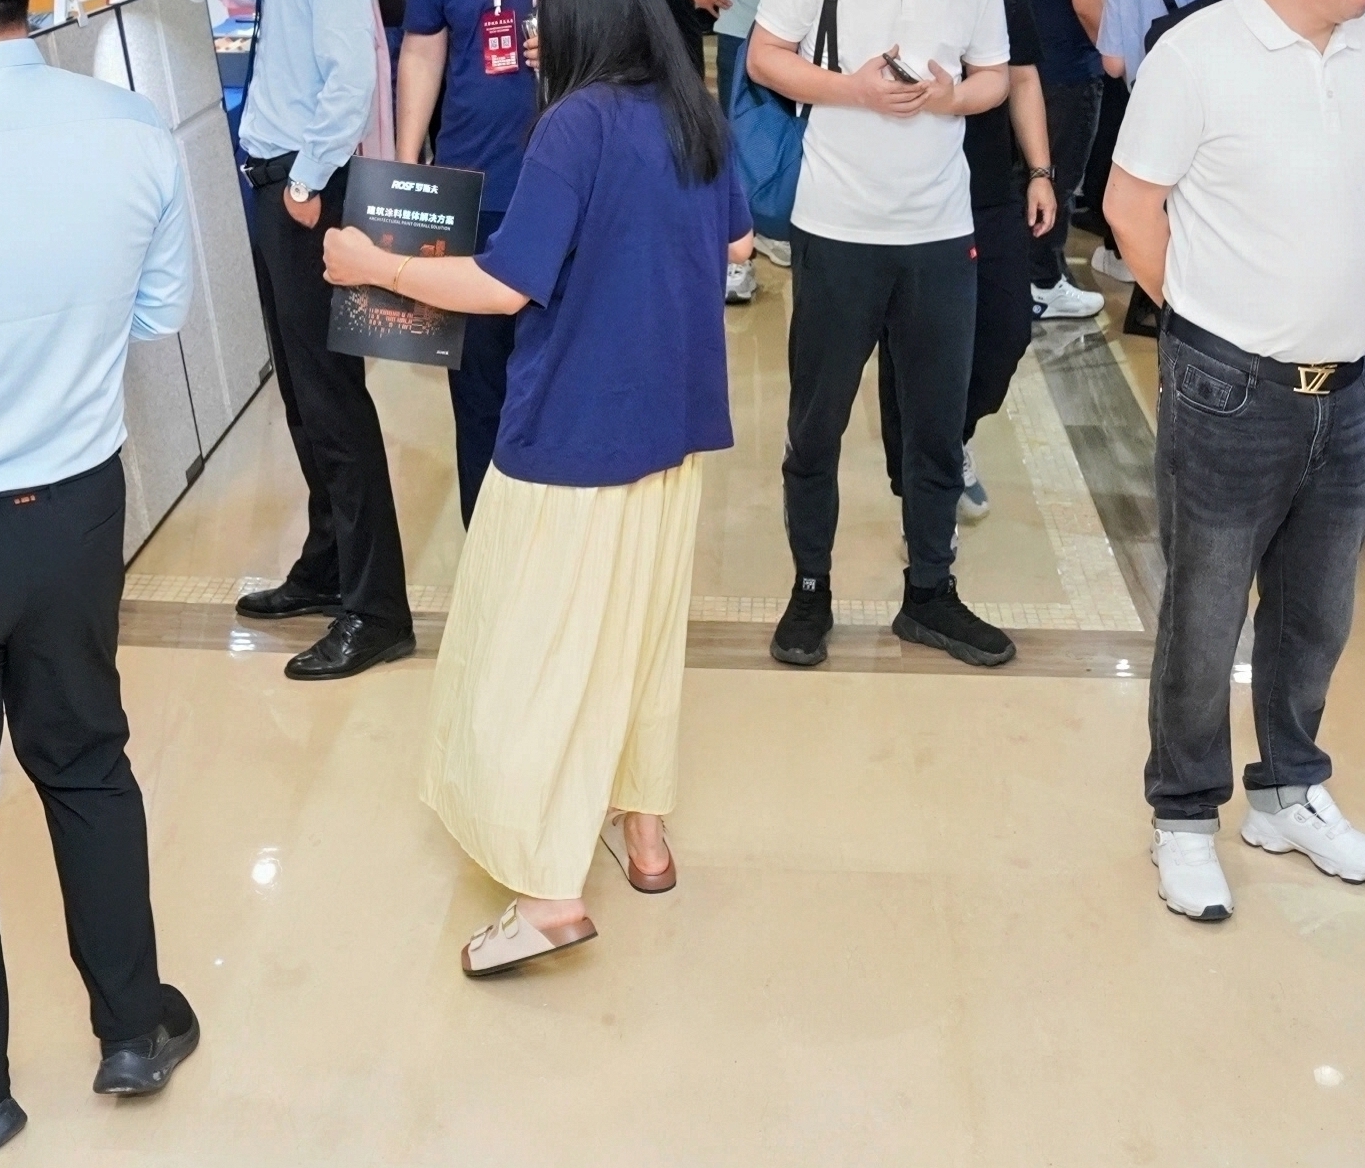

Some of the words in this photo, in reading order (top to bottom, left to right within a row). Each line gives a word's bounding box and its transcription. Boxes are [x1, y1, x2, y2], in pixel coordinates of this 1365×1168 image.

[391, 180, 415, 191] ROSF
[366, 205, 455, 226] 建筑涂料整体解决方案
